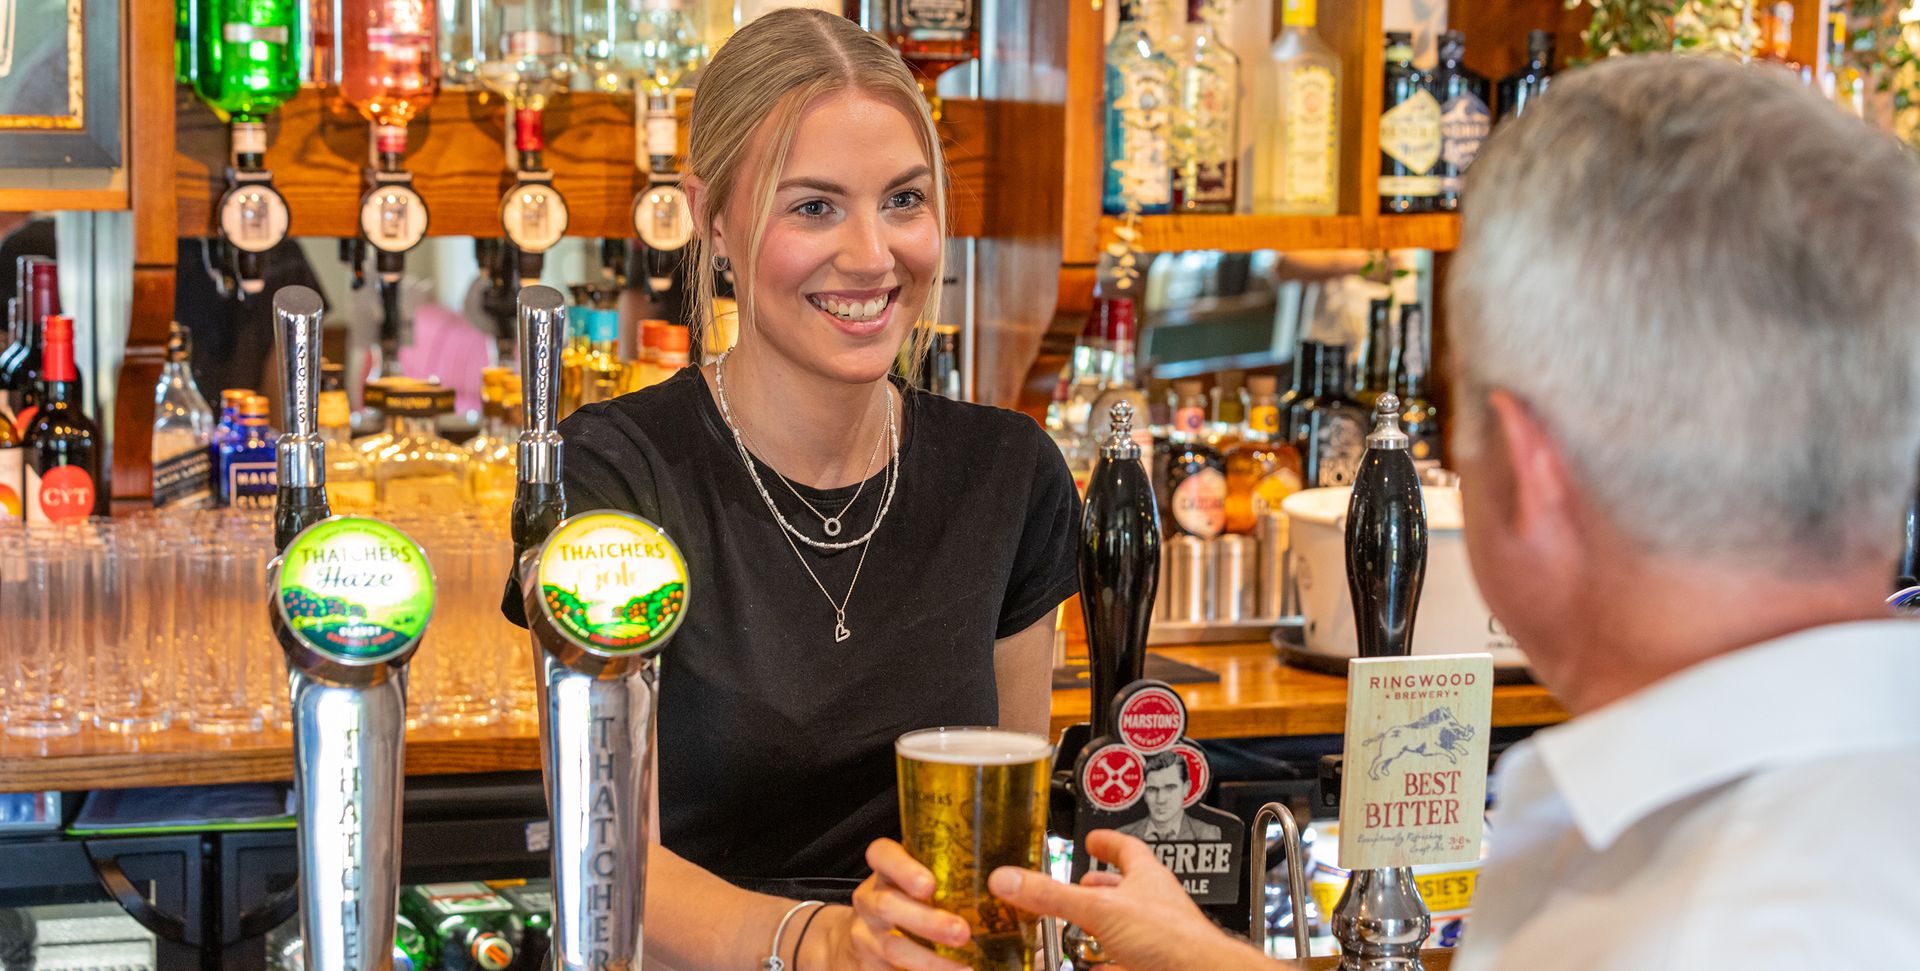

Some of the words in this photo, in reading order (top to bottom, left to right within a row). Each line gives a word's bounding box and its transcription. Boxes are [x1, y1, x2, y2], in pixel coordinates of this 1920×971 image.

[42, 487, 90, 507] CYT
[302, 543, 412, 565] THATCHERS
[560, 541, 667, 562] THATCHERS
[317, 565, 393, 589] Haze
[1369, 673, 1476, 690] RINGWOOD
[1394, 690, 1451, 701] BREWERY
[1122, 711, 1181, 730] MARSTON'S
[1404, 769, 1462, 797] BEST
[1365, 799, 1460, 829] BITTER
[339, 728, 361, 971] THATCHE
[1417, 875, 1469, 898] SIE'S
